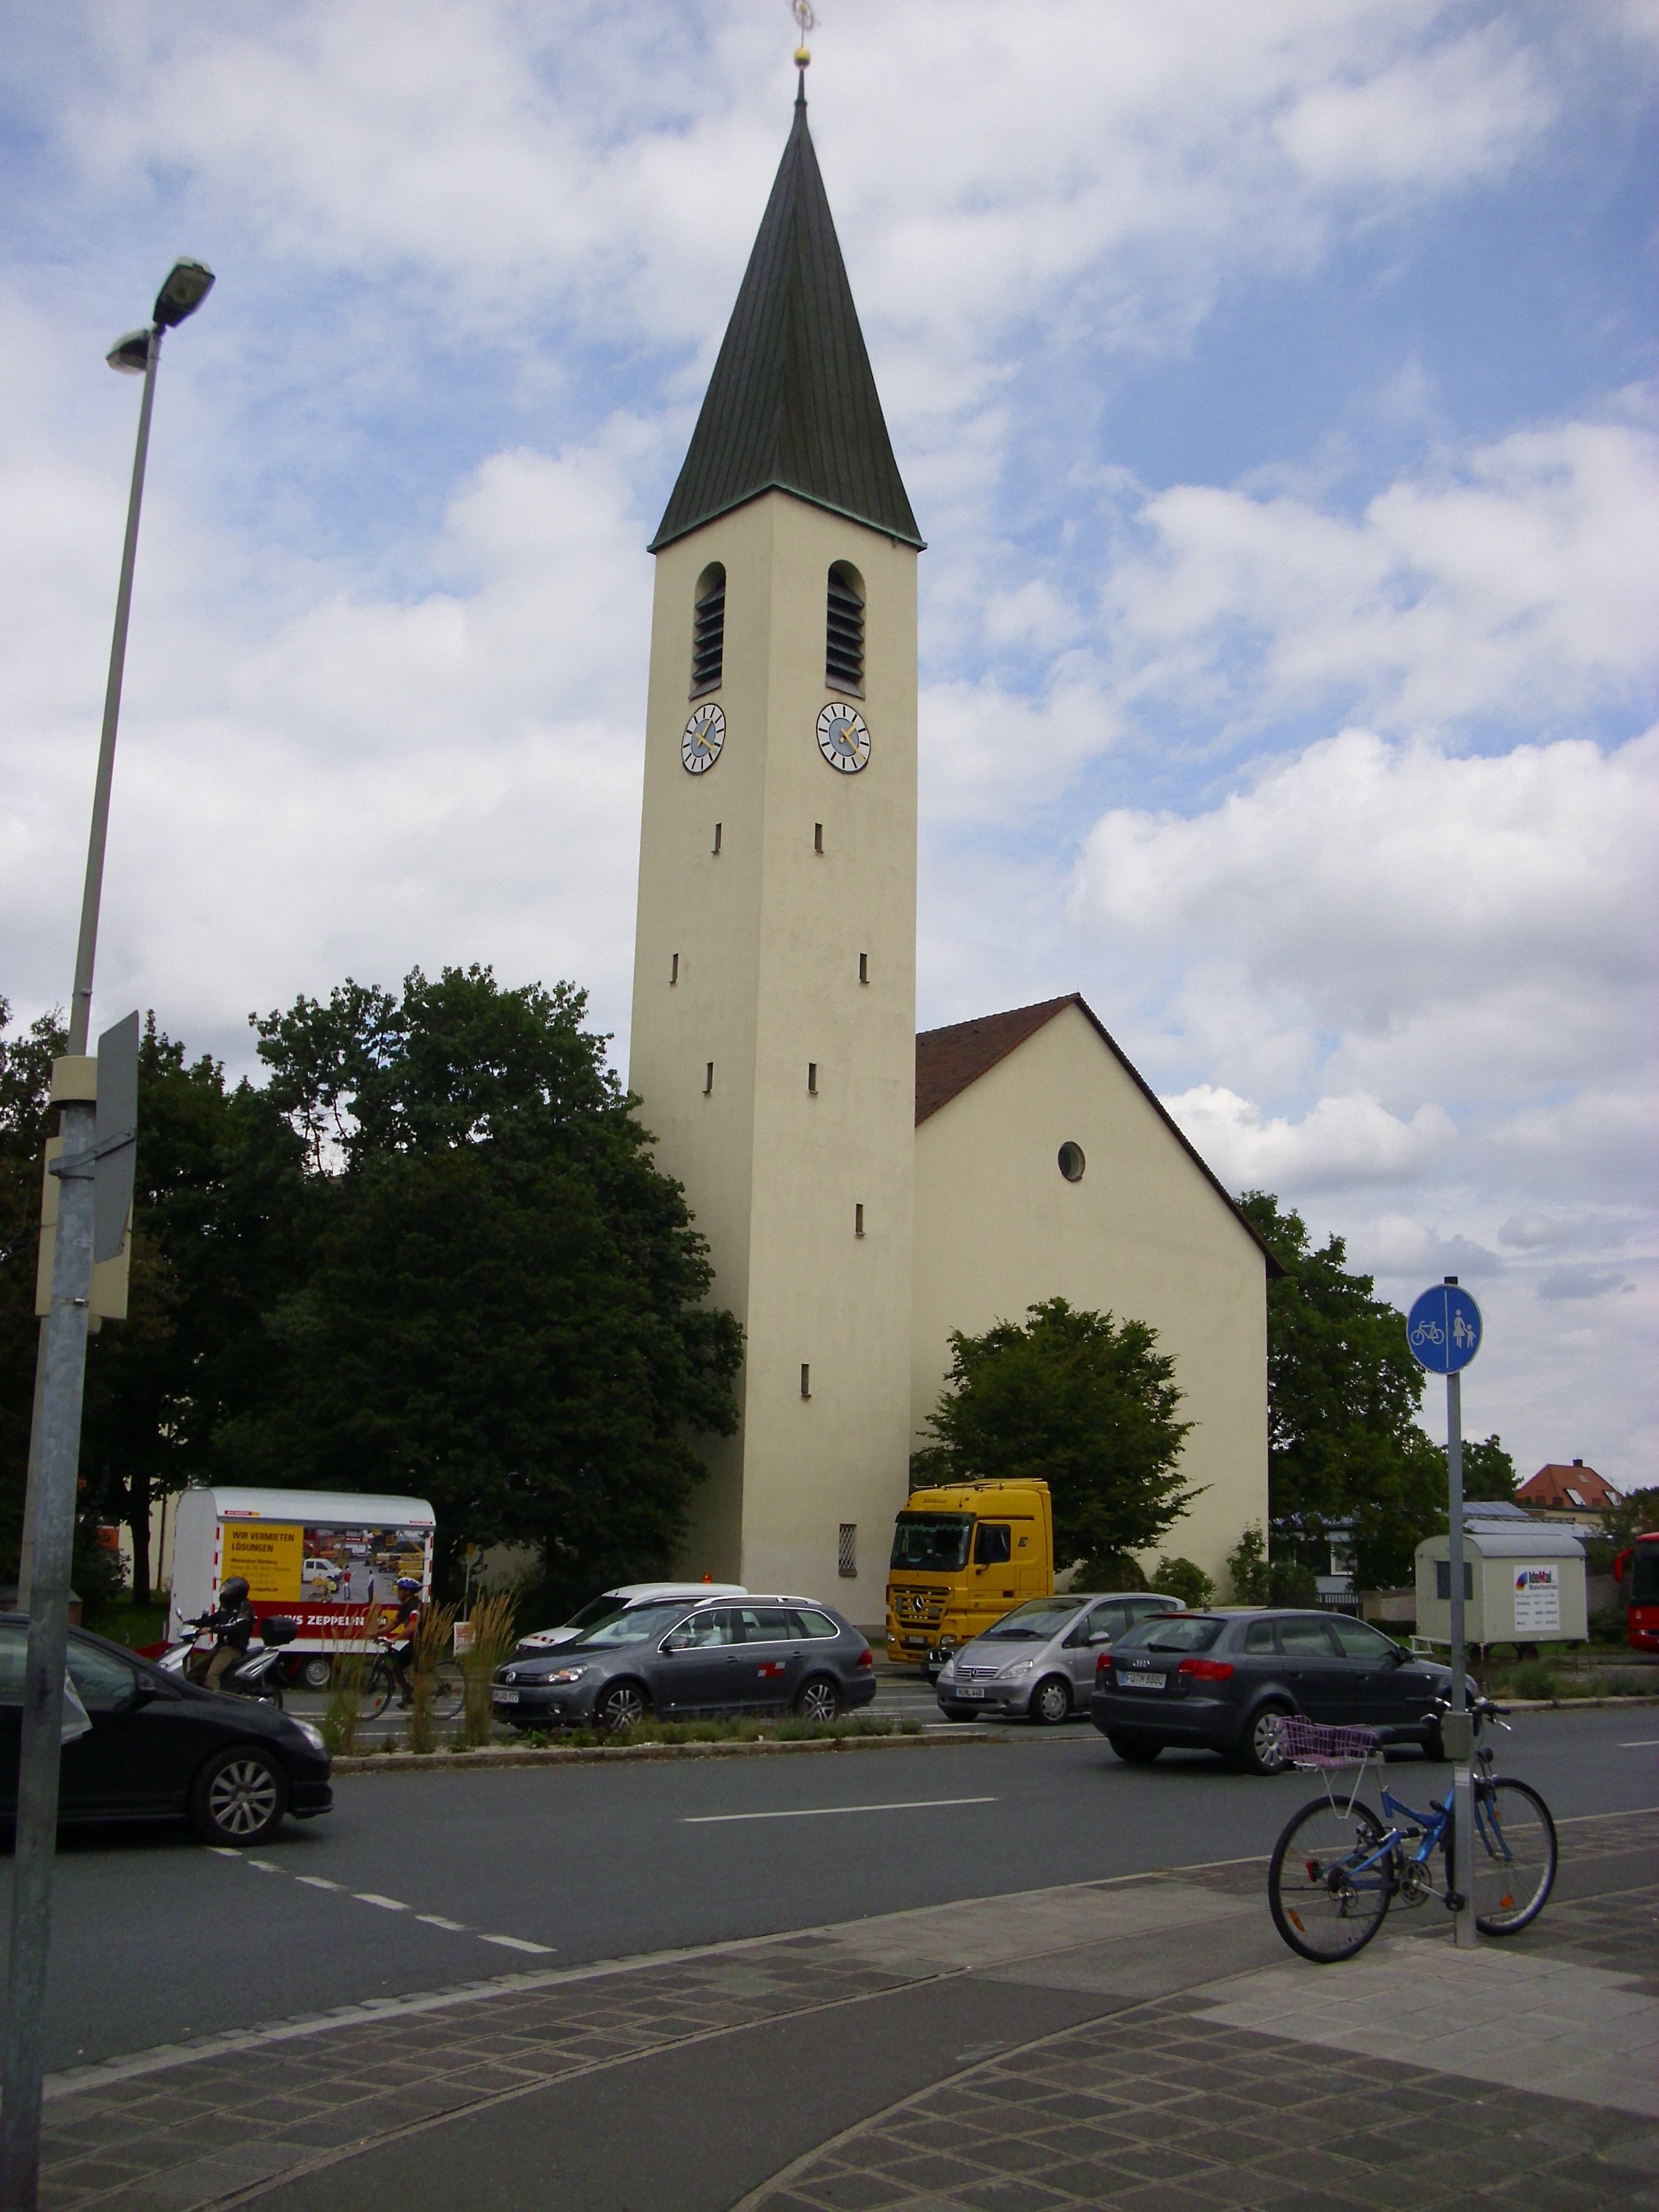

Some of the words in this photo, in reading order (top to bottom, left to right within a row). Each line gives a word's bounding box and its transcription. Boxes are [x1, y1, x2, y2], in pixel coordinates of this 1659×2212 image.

[232, 1531, 248, 1540] WIR
[250, 1532, 295, 1542] VERMIETEN
[232, 1542, 274, 1552] LÖSUNGEN
